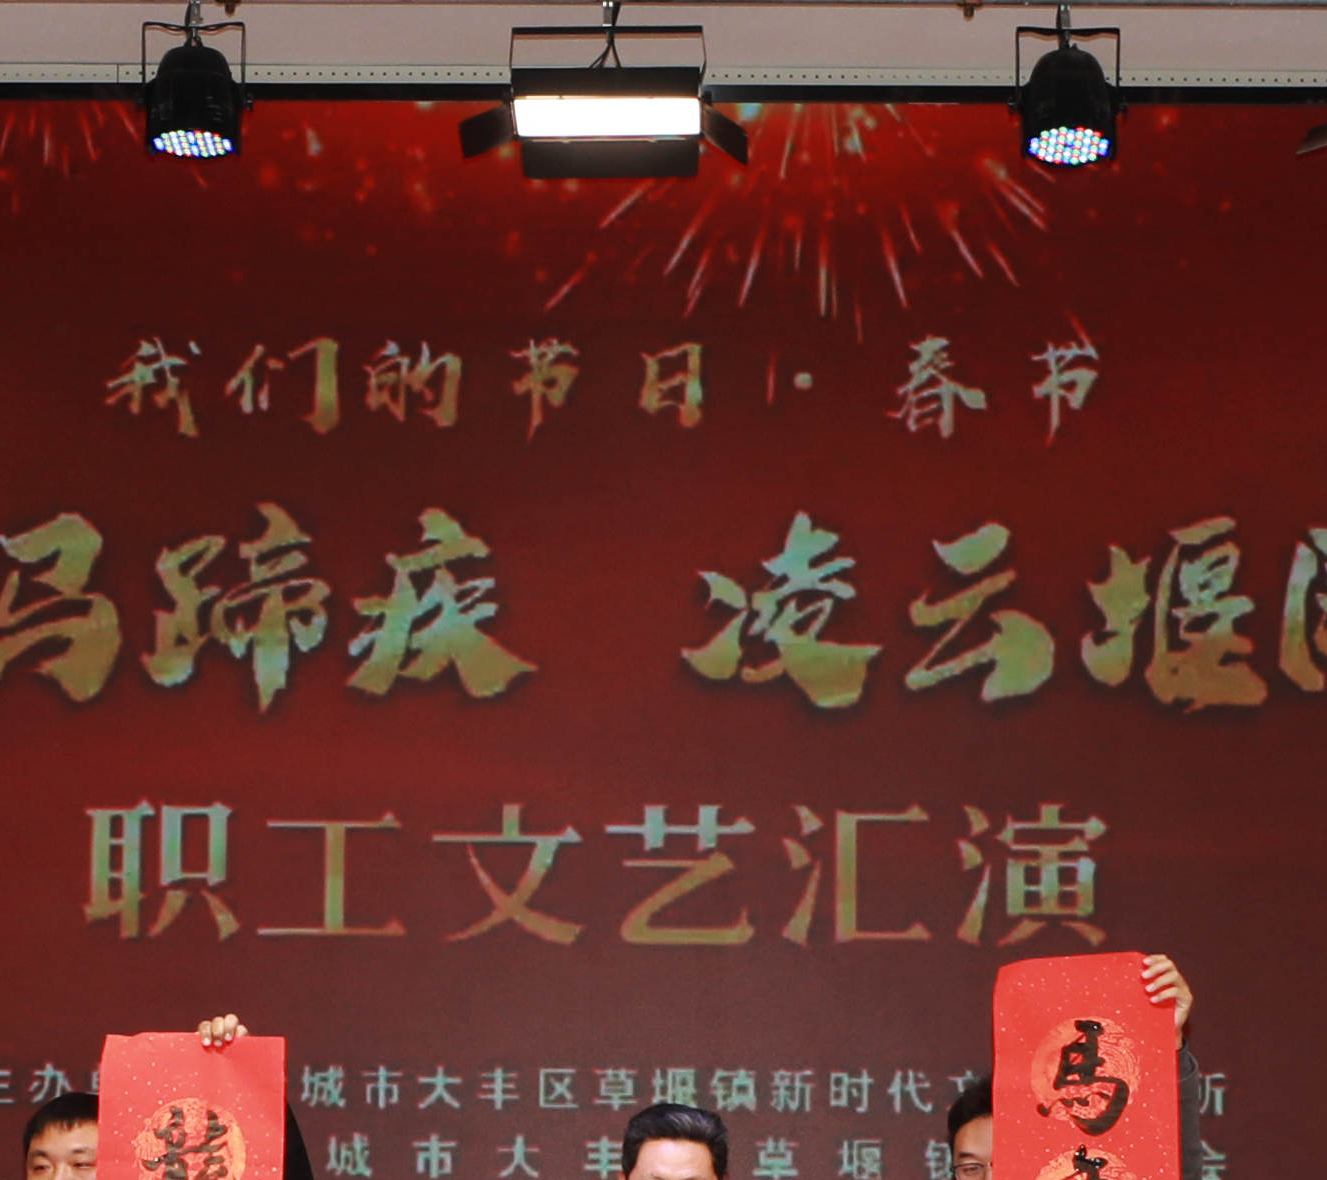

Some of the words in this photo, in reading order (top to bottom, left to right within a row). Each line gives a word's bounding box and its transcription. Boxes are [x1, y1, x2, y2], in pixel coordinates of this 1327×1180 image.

[84, 800, 1108, 947] 职工文艺汇演
